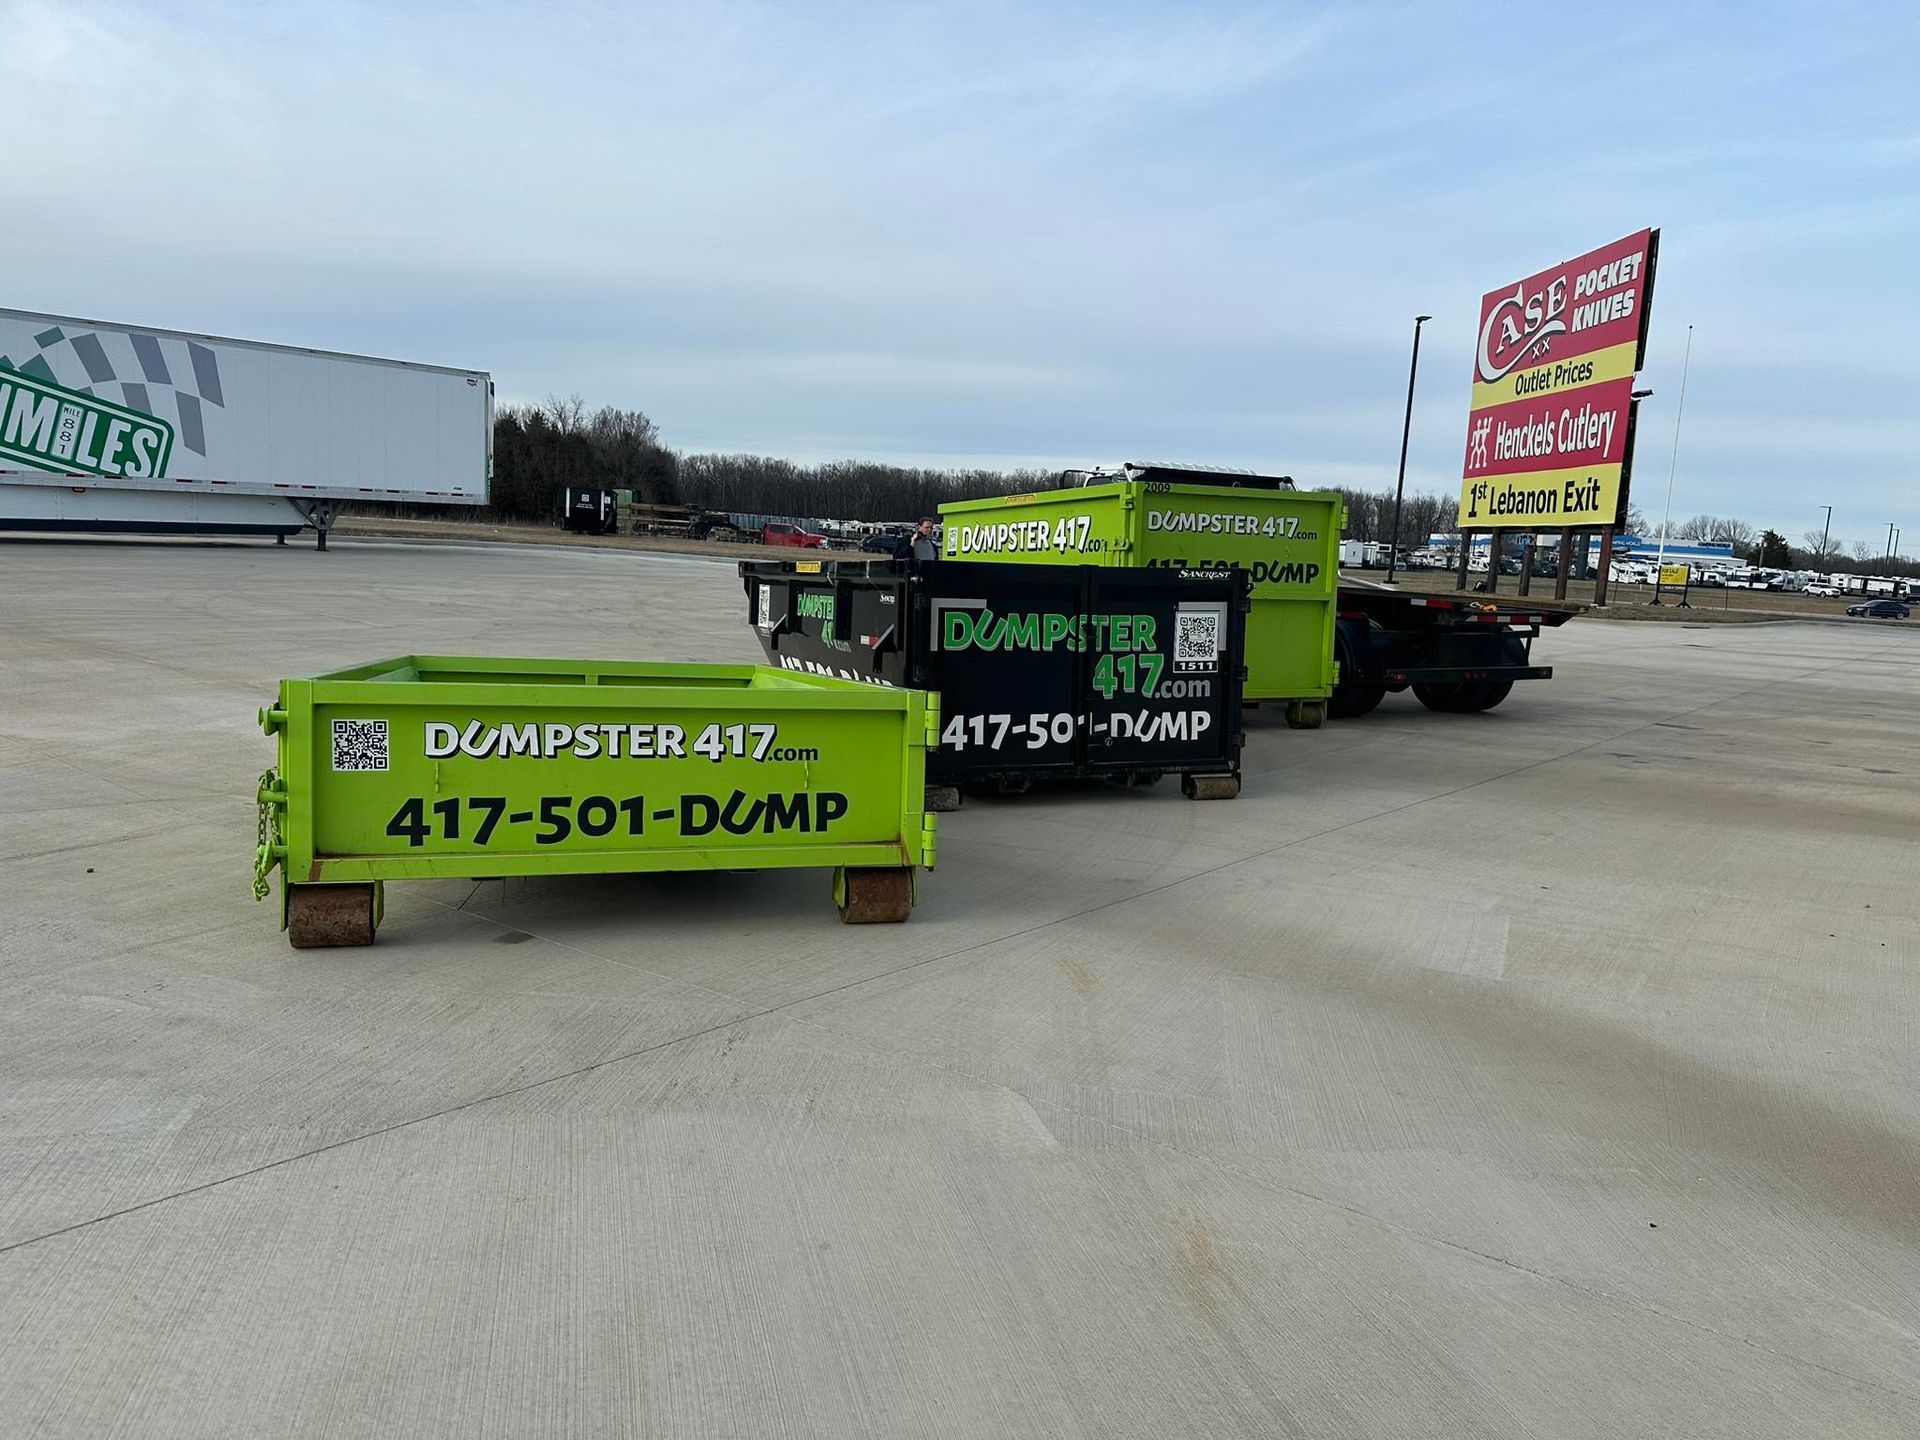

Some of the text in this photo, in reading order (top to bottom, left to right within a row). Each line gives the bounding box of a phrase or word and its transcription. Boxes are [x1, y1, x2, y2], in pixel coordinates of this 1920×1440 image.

[1574, 251, 1643, 300] POCKET
[1477, 275, 1567, 384] CASE
[1571, 289, 1635, 332] KNIVES
[1515, 359, 1593, 396] Outlet Prices
[63, 406, 81, 418] MILE
[1494, 402, 1617, 461] Henckels Cutlery
[1145, 483, 1171, 493] 2009
[1468, 477, 1600, 518] 1st Lebanon Exit
[961, 521, 1050, 554] DUMPSTER
[1148, 510, 1317, 540] DUMPSTER 417.com
[1178, 569, 1231, 580] SANCREST
[944, 608, 1157, 652] DUMPSTER
[1093, 653, 1211, 699] 417.com
[1179, 662, 1214, 671] 1511
[424, 718, 819, 763] DUMPSTER 417.com
[385, 788, 849, 848] 417-501-DUMP
